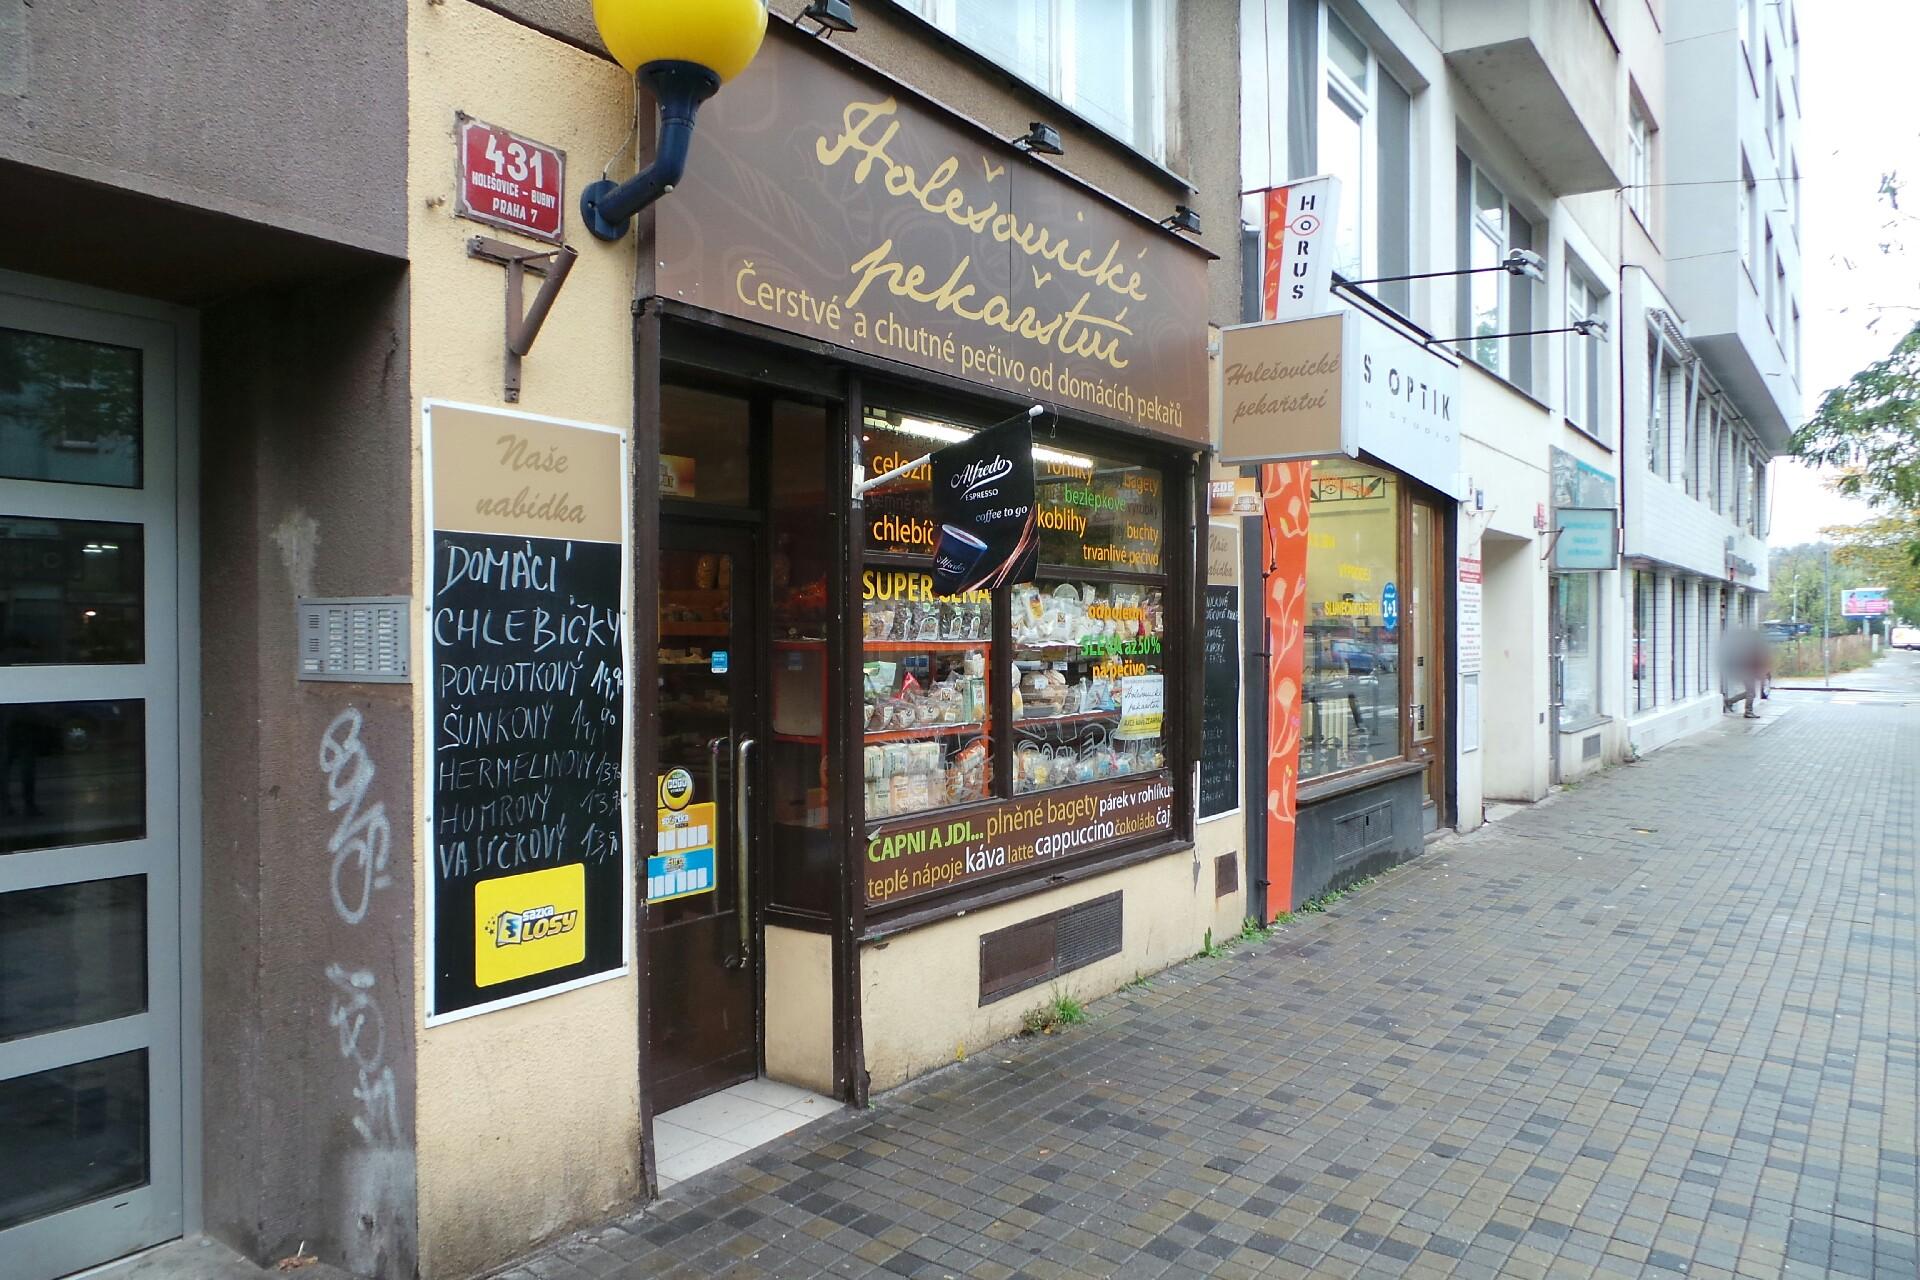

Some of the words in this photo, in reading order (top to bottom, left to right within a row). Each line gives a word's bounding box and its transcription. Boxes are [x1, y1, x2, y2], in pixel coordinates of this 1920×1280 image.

[485, 134, 545, 189] 431
[471, 170, 519, 198] HOLEŠOVICE
[531, 192, 556, 208] BUBNY
[815, 96, 1148, 302] Holešovické
[493, 198, 526, 221] PRAHA
[530, 208, 538, 224] 7
[1291, 194, 1316, 300] HORUS
[845, 239, 1133, 369] pekařství
[736, 260, 842, 330] Čerstvé
[853, 315, 868, 339] a
[875, 311, 955, 363] chutné
[961, 343, 1026, 389] pečivo
[1029, 361, 1053, 394] od
[1058, 373, 1135, 416] domácích
[1137, 397, 1183, 429] pekařů
[1224, 351, 1340, 386] Holešovické
[1233, 389, 1329, 424] pekařství
[1388, 368, 1451, 421] OPTIK
[496, 433, 569, 474] Naše
[950, 454, 1013, 489] Alfredo
[475, 486, 586, 525] nabídka
[965, 488, 999, 501] ESPRESSO
[976, 509, 1002, 523] coffee
[1003, 507, 1014, 518] to
[1015, 505, 1028, 518] go
[1037, 503, 1087, 538] koblihy
[1126, 520, 1159, 545] buchty
[1082, 543, 1127, 563] trvanlivé
[862, 570, 934, 605] SUPER
[1092, 664, 1109, 679] na
[1110, 659, 1146, 681] pečivo
[987, 801, 1043, 841] plněné
[1047, 793, 1098, 826] bagety
[1099, 790, 1129, 816] párek
[1129, 794, 1137, 806] v
[1137, 783, 1170, 805] rohlíku
[867, 870, 909, 899] teplé
[912, 857, 963, 890] nápoje
[965, 848, 1005, 874] káva
[1008, 842, 1034, 864] latte
[1035, 820, 1114, 858] cappuccino
[1114, 810, 1155, 836] čokoláda
[1156, 805, 1171, 829] čaj
[929, 832, 941, 851] A
[521, 909, 578, 942] LOSY
